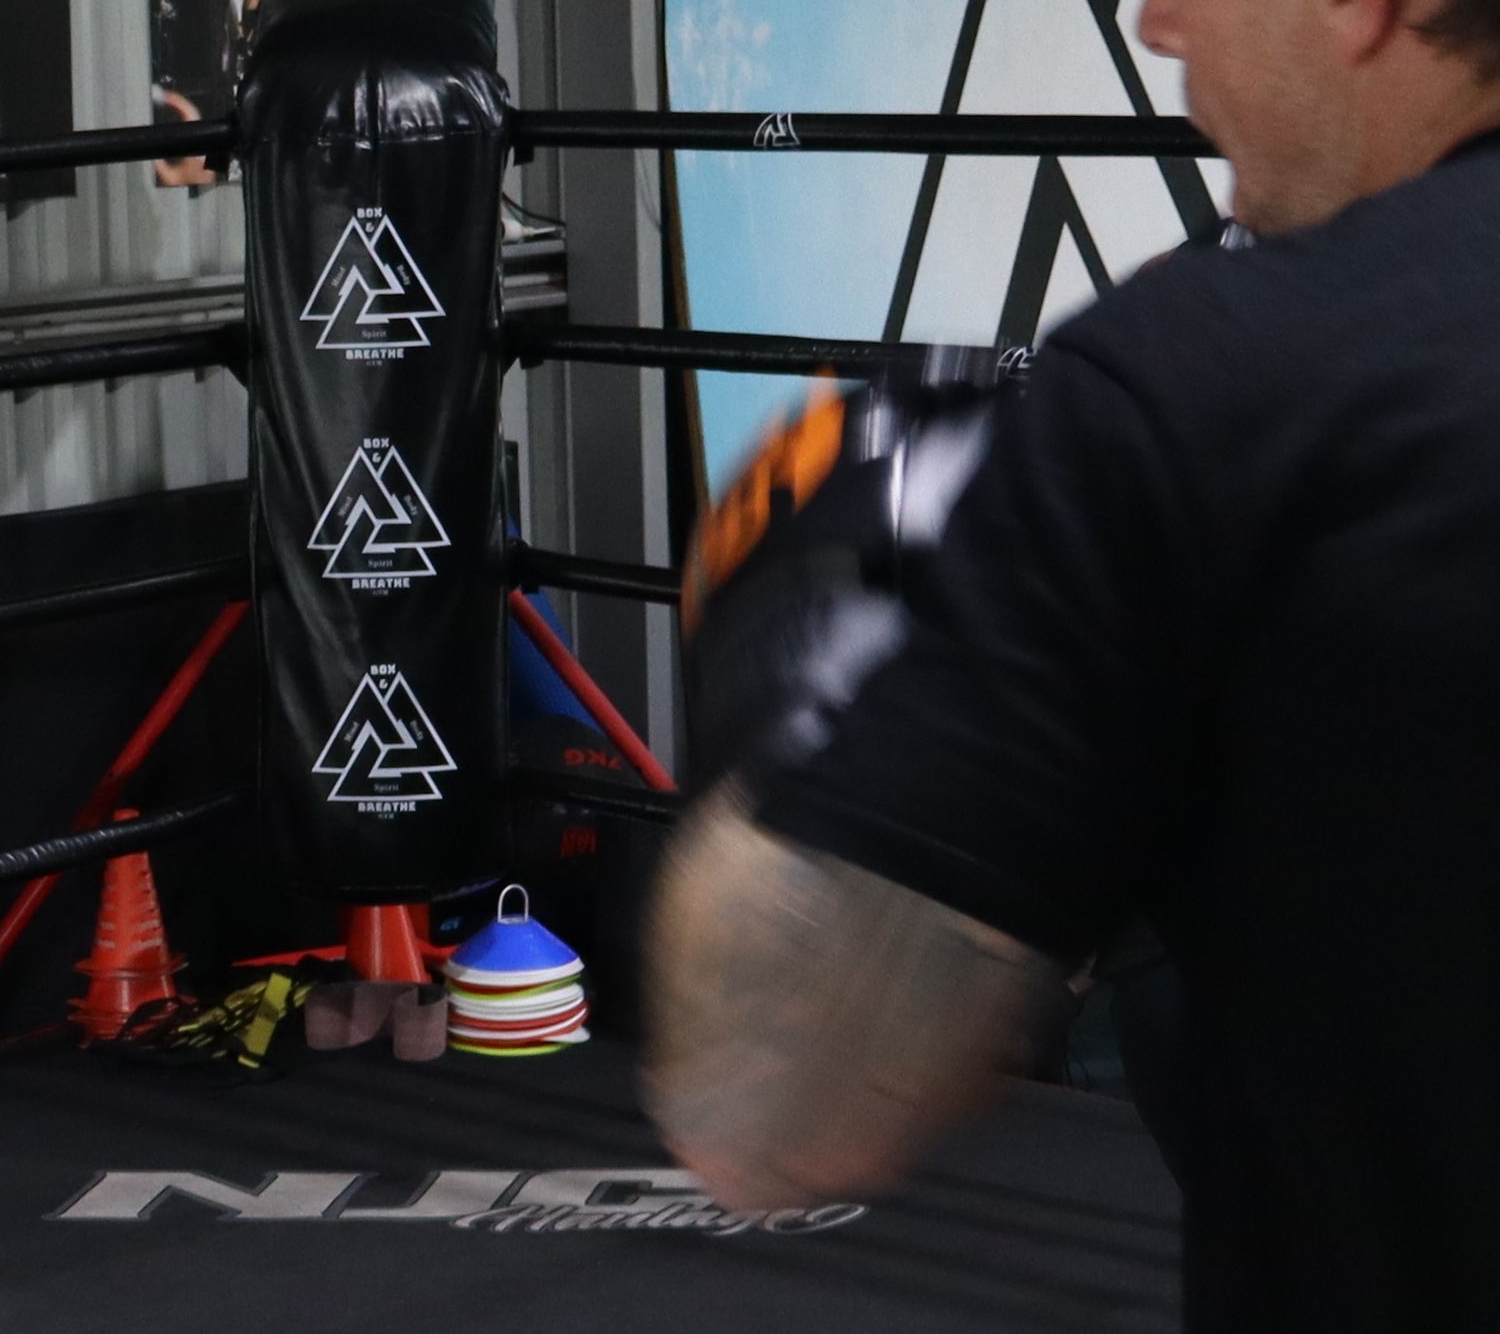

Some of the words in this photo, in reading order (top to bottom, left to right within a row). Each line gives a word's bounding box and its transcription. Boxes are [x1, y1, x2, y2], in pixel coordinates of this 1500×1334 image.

[356, 207, 383, 218] BOX
[365, 221, 375, 233] &
[345, 348, 405, 360] BREATHE
[363, 437, 390, 448] BOX
[372, 451, 382, 463] &
[351, 577, 411, 590] BREATHE
[370, 663, 397, 675] BOX
[379, 678, 389, 690] &
[357, 801, 417, 813] BREATHE
